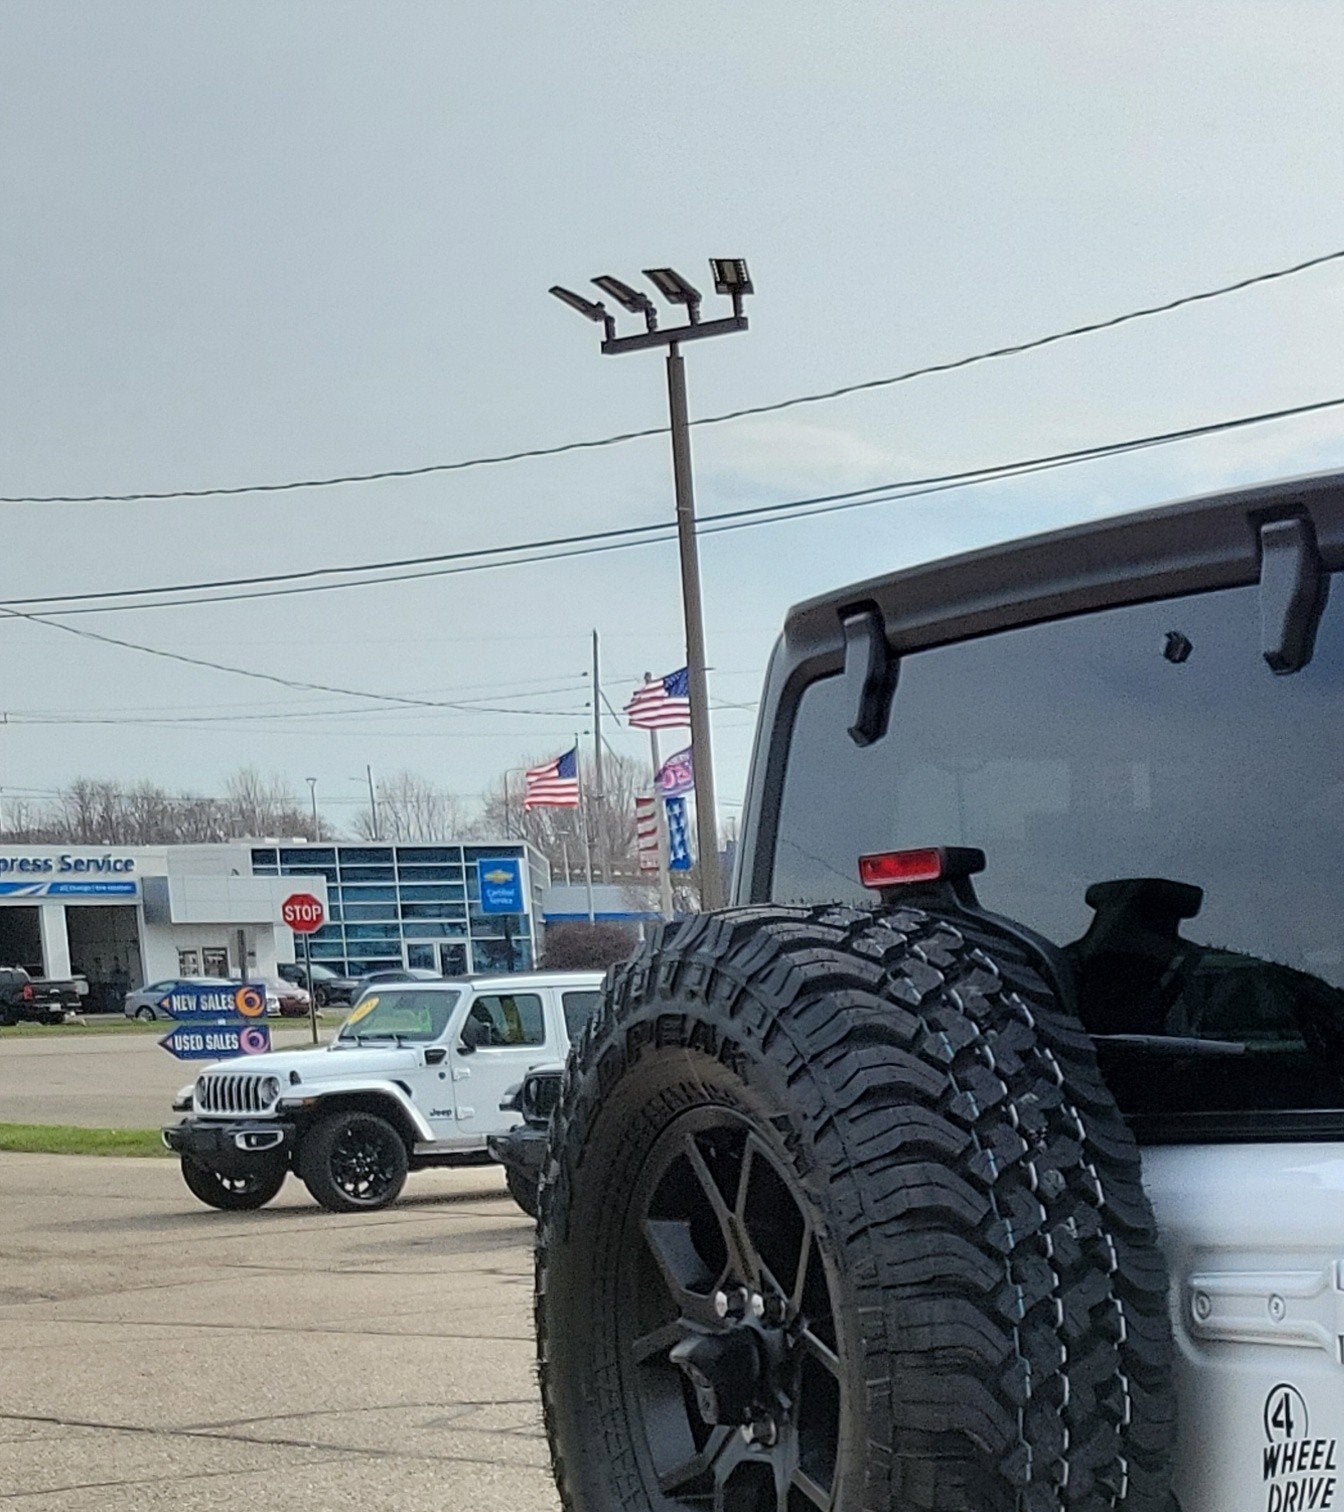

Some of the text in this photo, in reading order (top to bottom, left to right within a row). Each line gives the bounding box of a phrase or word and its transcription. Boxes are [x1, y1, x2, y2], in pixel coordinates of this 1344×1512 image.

[58, 854, 135, 873] Service
[284, 904, 322, 922] STOP
[172, 993, 235, 1012] NEW SALES
[174, 1033, 239, 1051] USED SALES
[1271, 1392, 1294, 1438] 4
[1263, 1439, 1337, 1481] WHEEL
